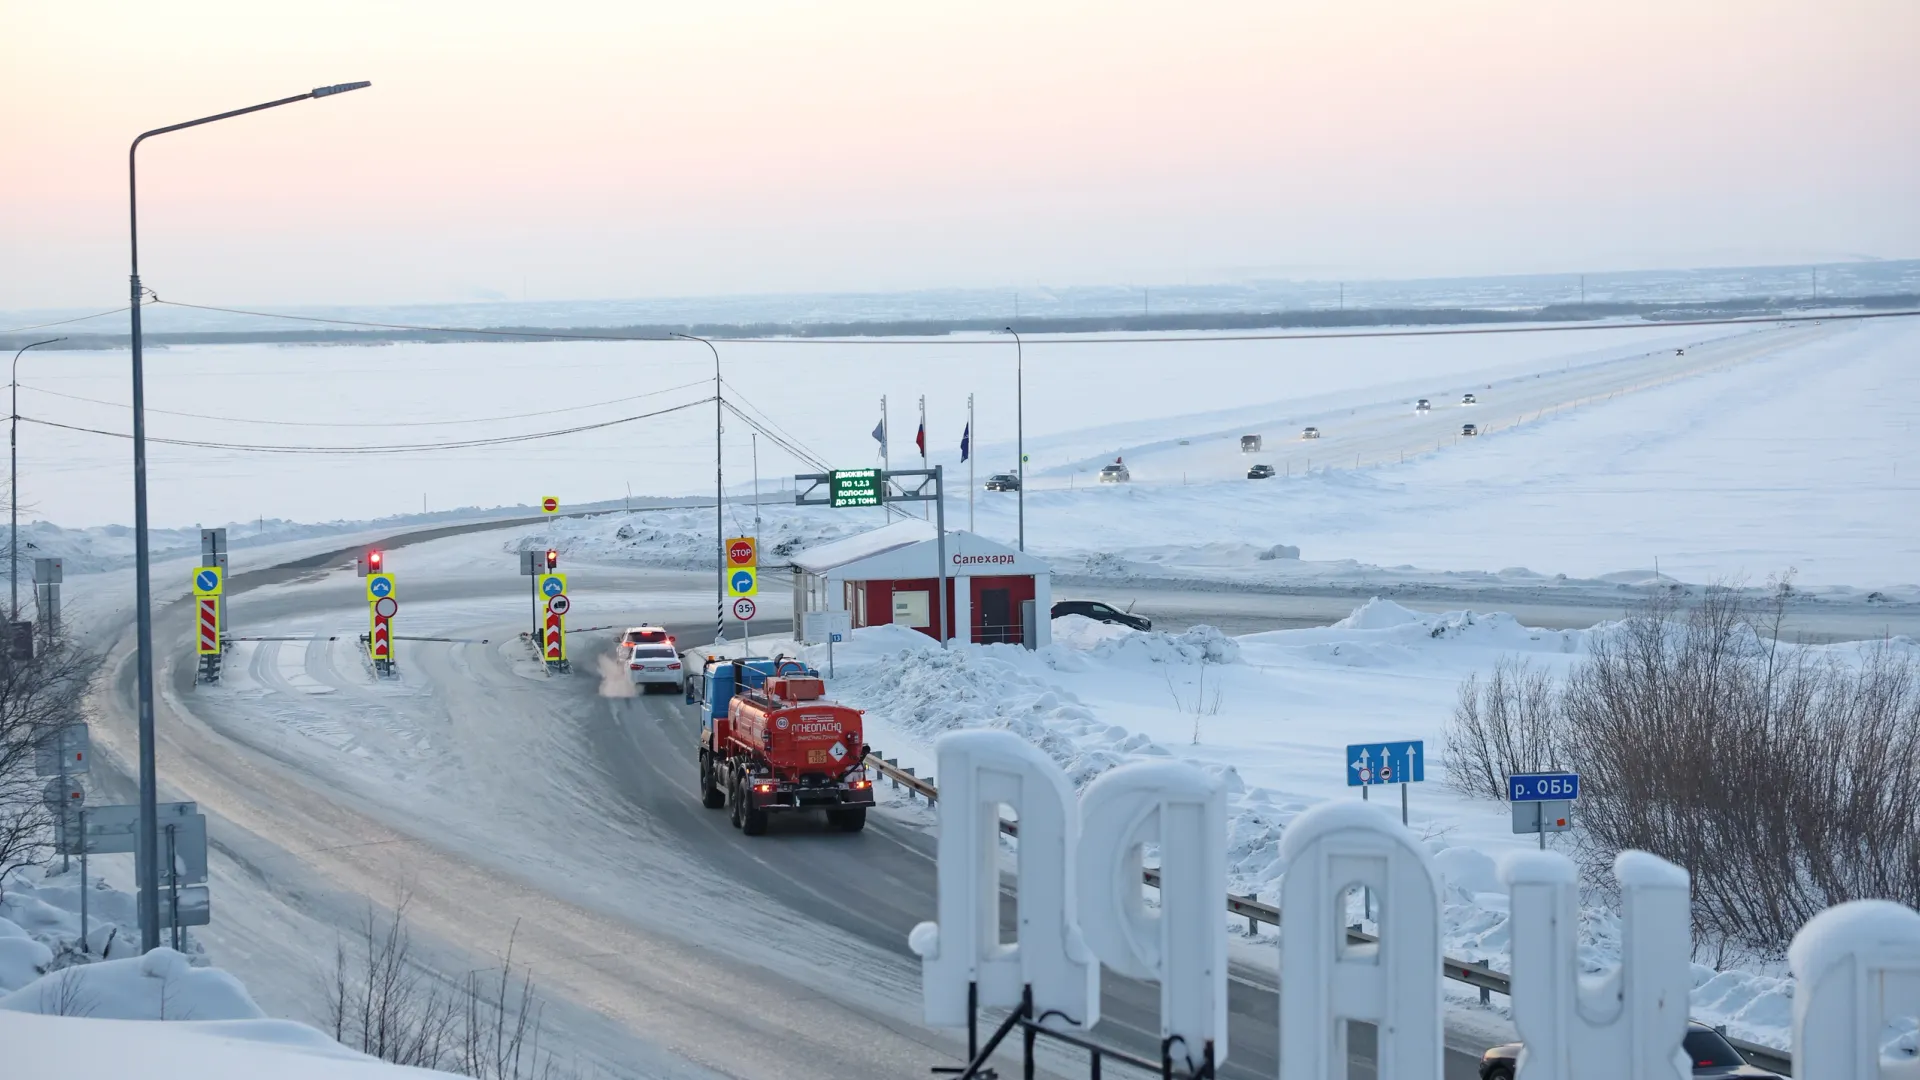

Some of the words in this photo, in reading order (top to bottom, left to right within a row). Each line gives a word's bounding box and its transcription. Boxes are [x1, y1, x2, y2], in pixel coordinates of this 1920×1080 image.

[836, 470, 875, 479] ДВИЖЕНИЕ
[731, 549, 752, 558] STOP
[953, 554, 1015, 564] Салехард
[792, 722, 842, 733] ОГНЕОПАСНО
[1515, 784, 1531, 799] р.
[1537, 779, 1573, 794] ОБЬ
